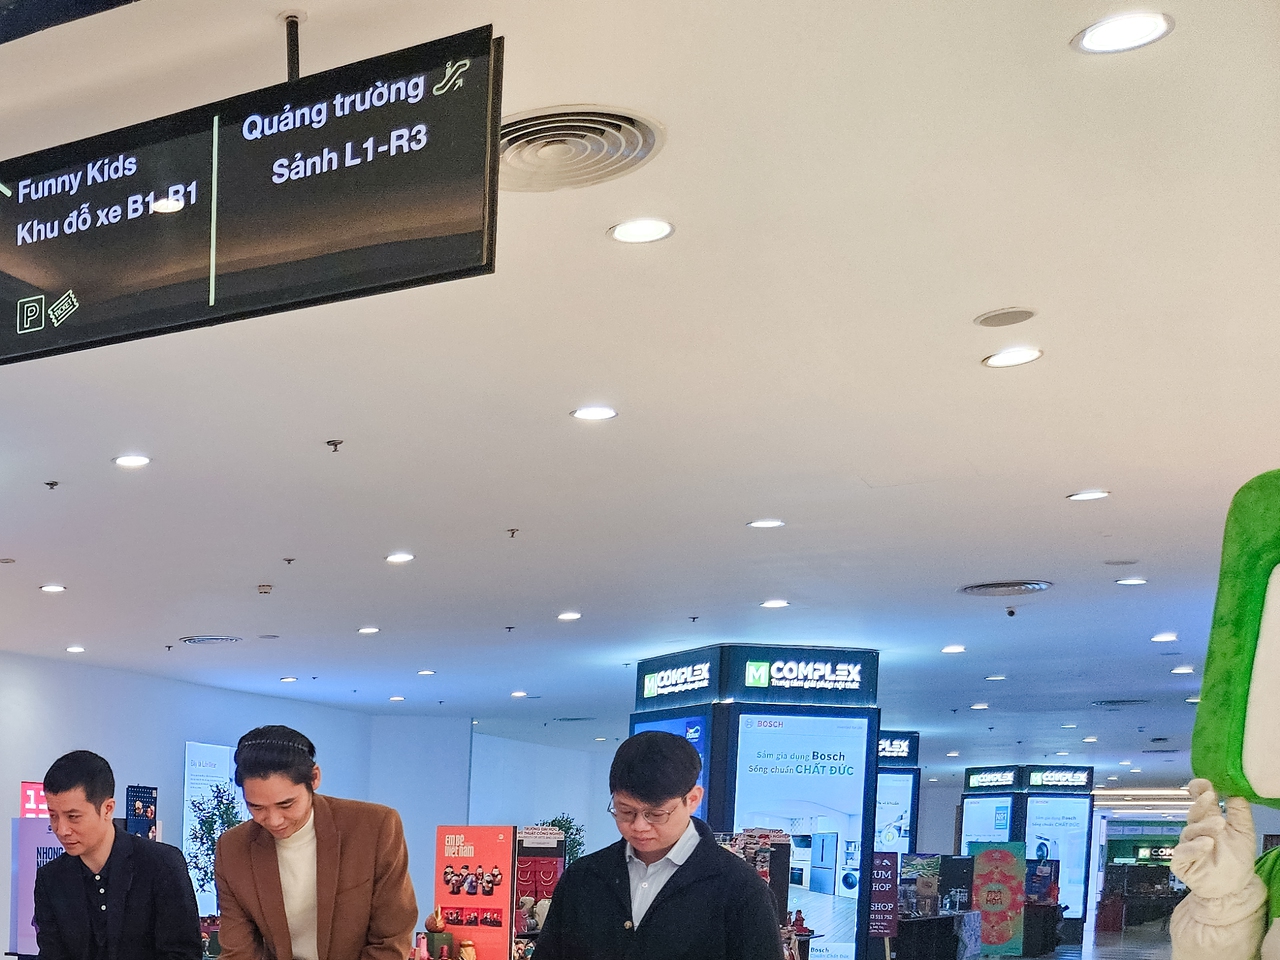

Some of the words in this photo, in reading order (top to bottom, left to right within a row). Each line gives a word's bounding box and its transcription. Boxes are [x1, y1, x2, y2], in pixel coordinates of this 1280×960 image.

[242, 99, 328, 142] Quảng
[332, 72, 426, 119] trường
[271, 141, 338, 184] Sảnh
[344, 123, 429, 166] L1-R3
[17, 168, 83, 205] Funny
[86, 152, 138, 187] Kids
[16, 214, 60, 246] Khu
[63, 202, 93, 236] đỗ
[96, 204, 123, 228] xe
[657, 661, 711, 687] COMPLEX
[770, 660, 862, 683] COMPLEX
[756, 719, 784, 729] BOSCH
[775, 751, 788, 762] gia
[789, 751, 810, 763] dụng
[811, 750, 846, 762] Bosch
[795, 761, 827, 775] CHẤT
[829, 762, 855, 776] ĐỨC
[979, 770, 1014, 782] COMPLEX
[1042, 770, 1088, 782] COMPLEX
